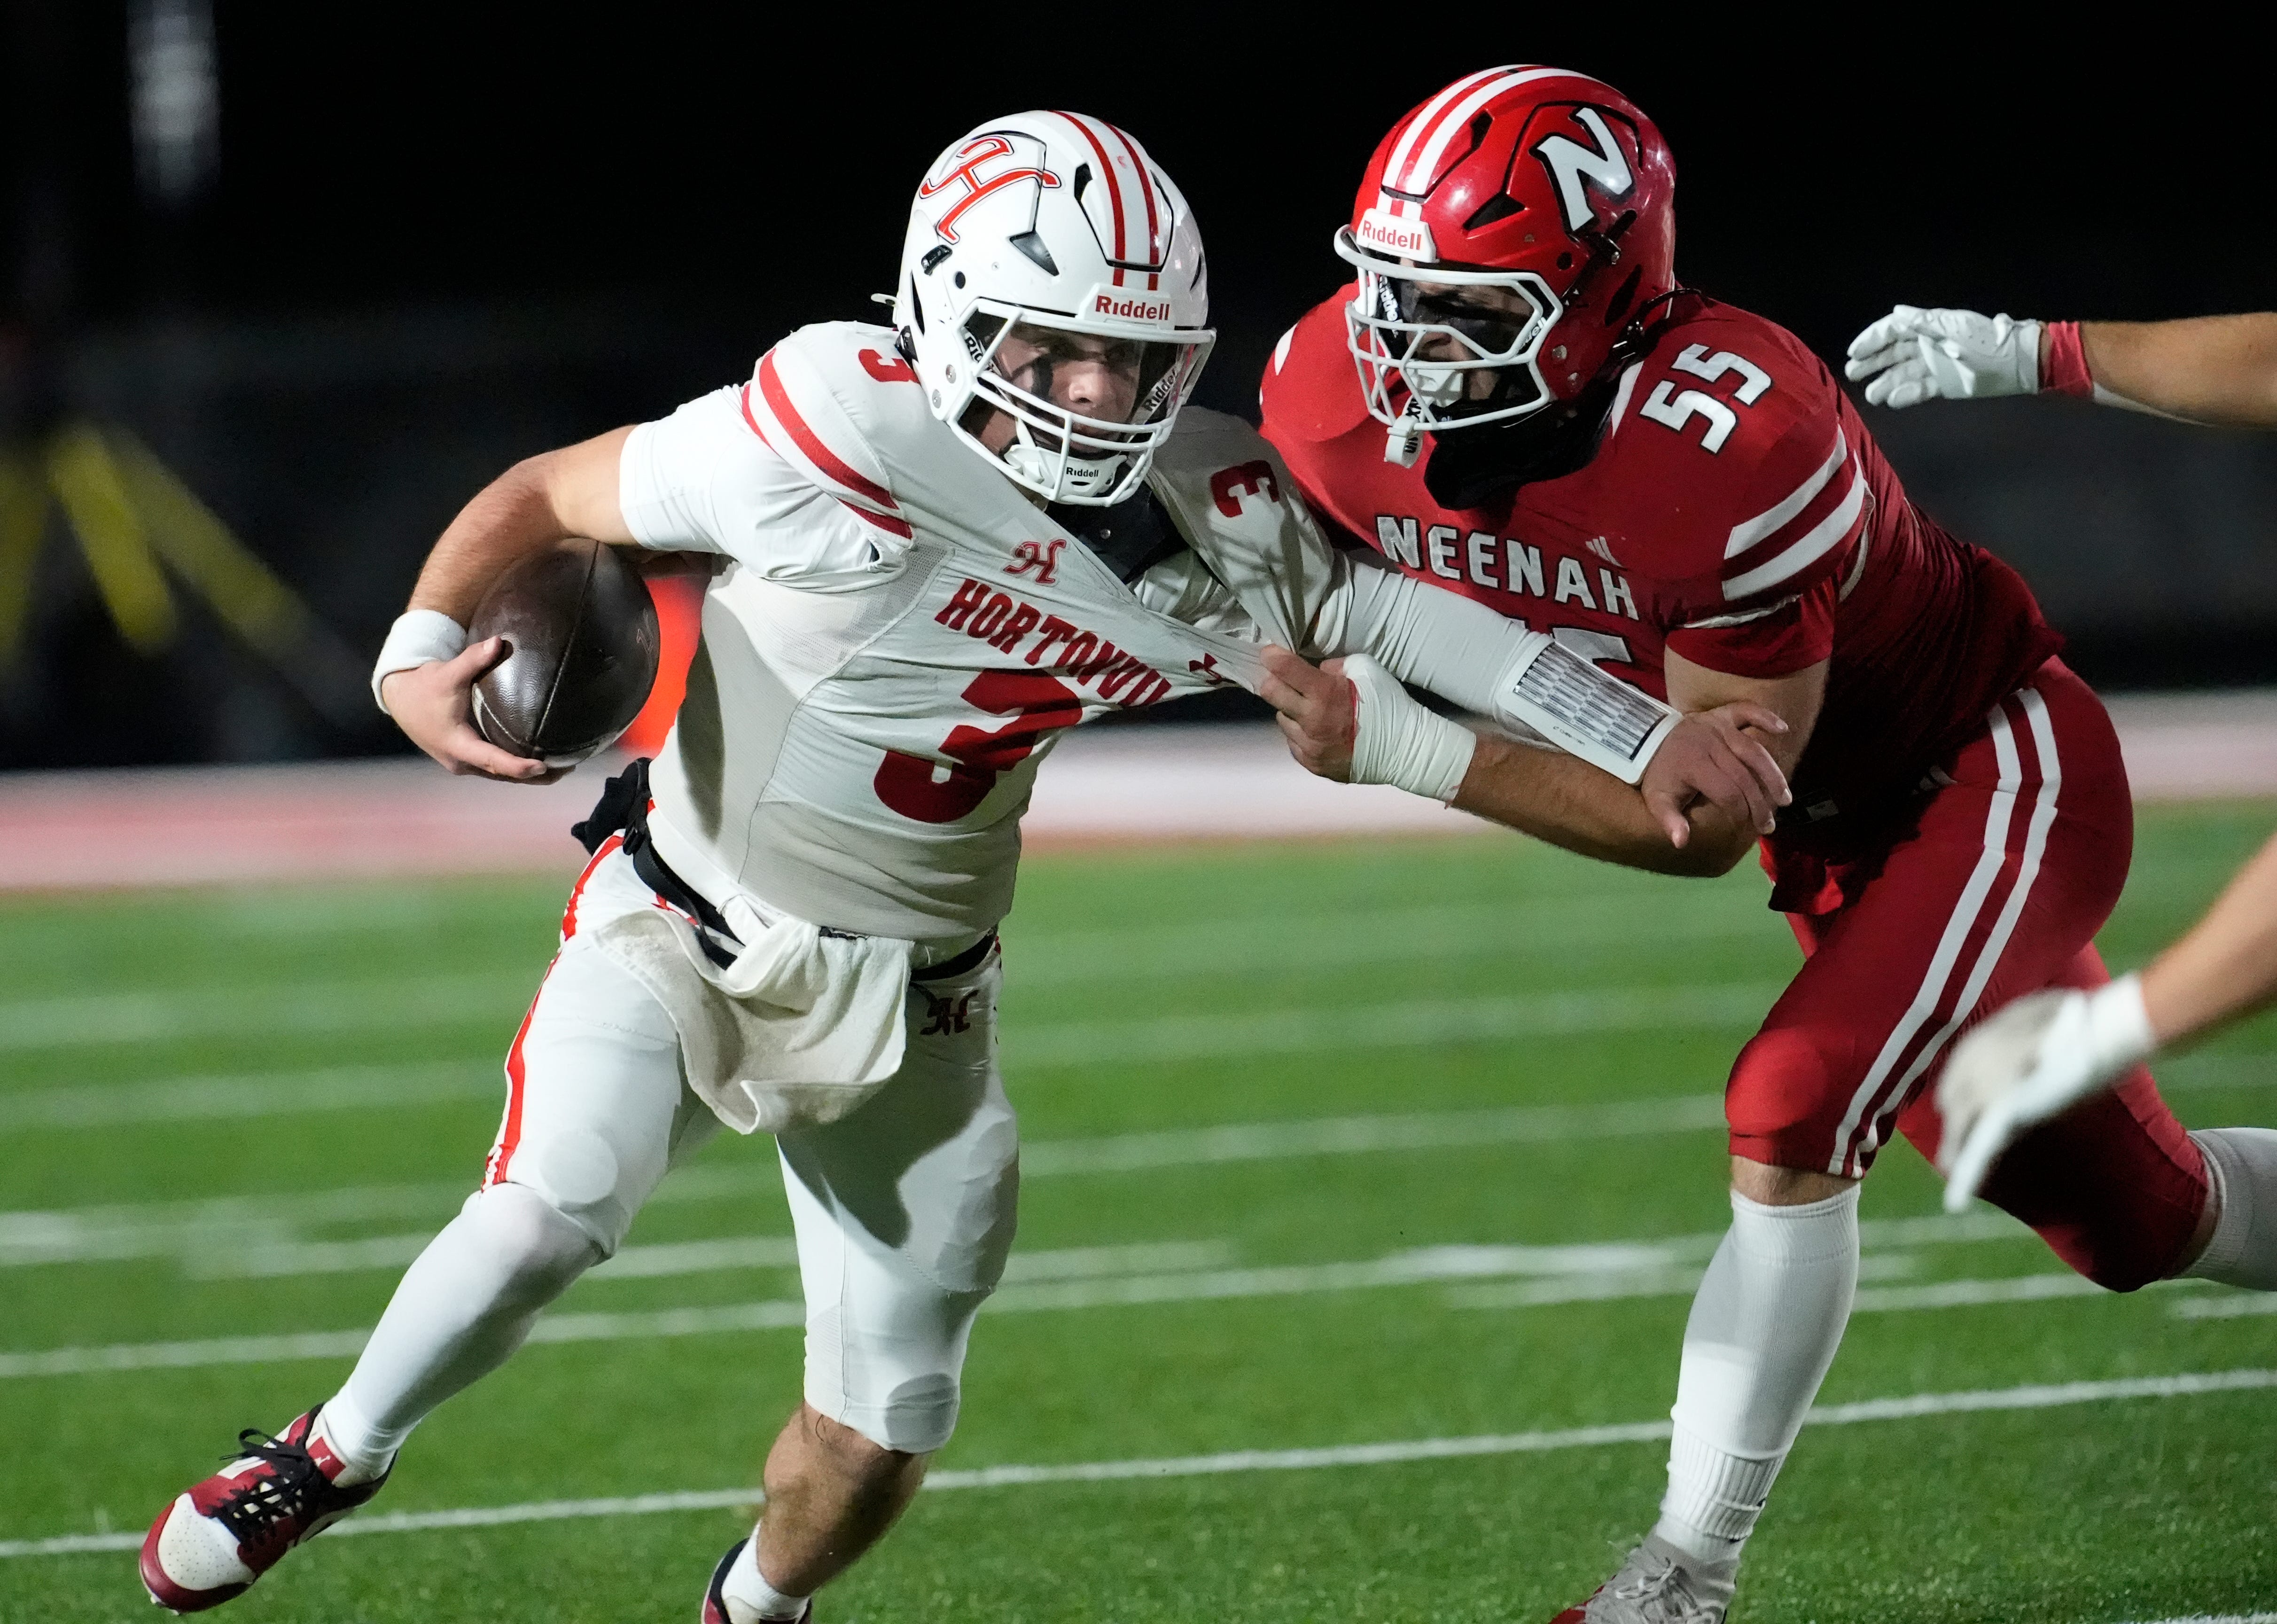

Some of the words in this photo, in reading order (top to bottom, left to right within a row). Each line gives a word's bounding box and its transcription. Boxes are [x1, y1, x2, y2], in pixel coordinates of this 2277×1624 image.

[919, 135, 1061, 244] H
[1531, 106, 1635, 235] N
[1363, 219, 1422, 250] Riddell
[1095, 295, 1170, 320] Riddell
[1142, 368, 1175, 412] Riddel
[1638, 342, 1773, 455] 55
[1066, 467, 1099, 477] Riddell
[1209, 460, 1280, 518] 3
[1376, 515, 1640, 621] NEENAH
[873, 668, 1083, 824] 3
